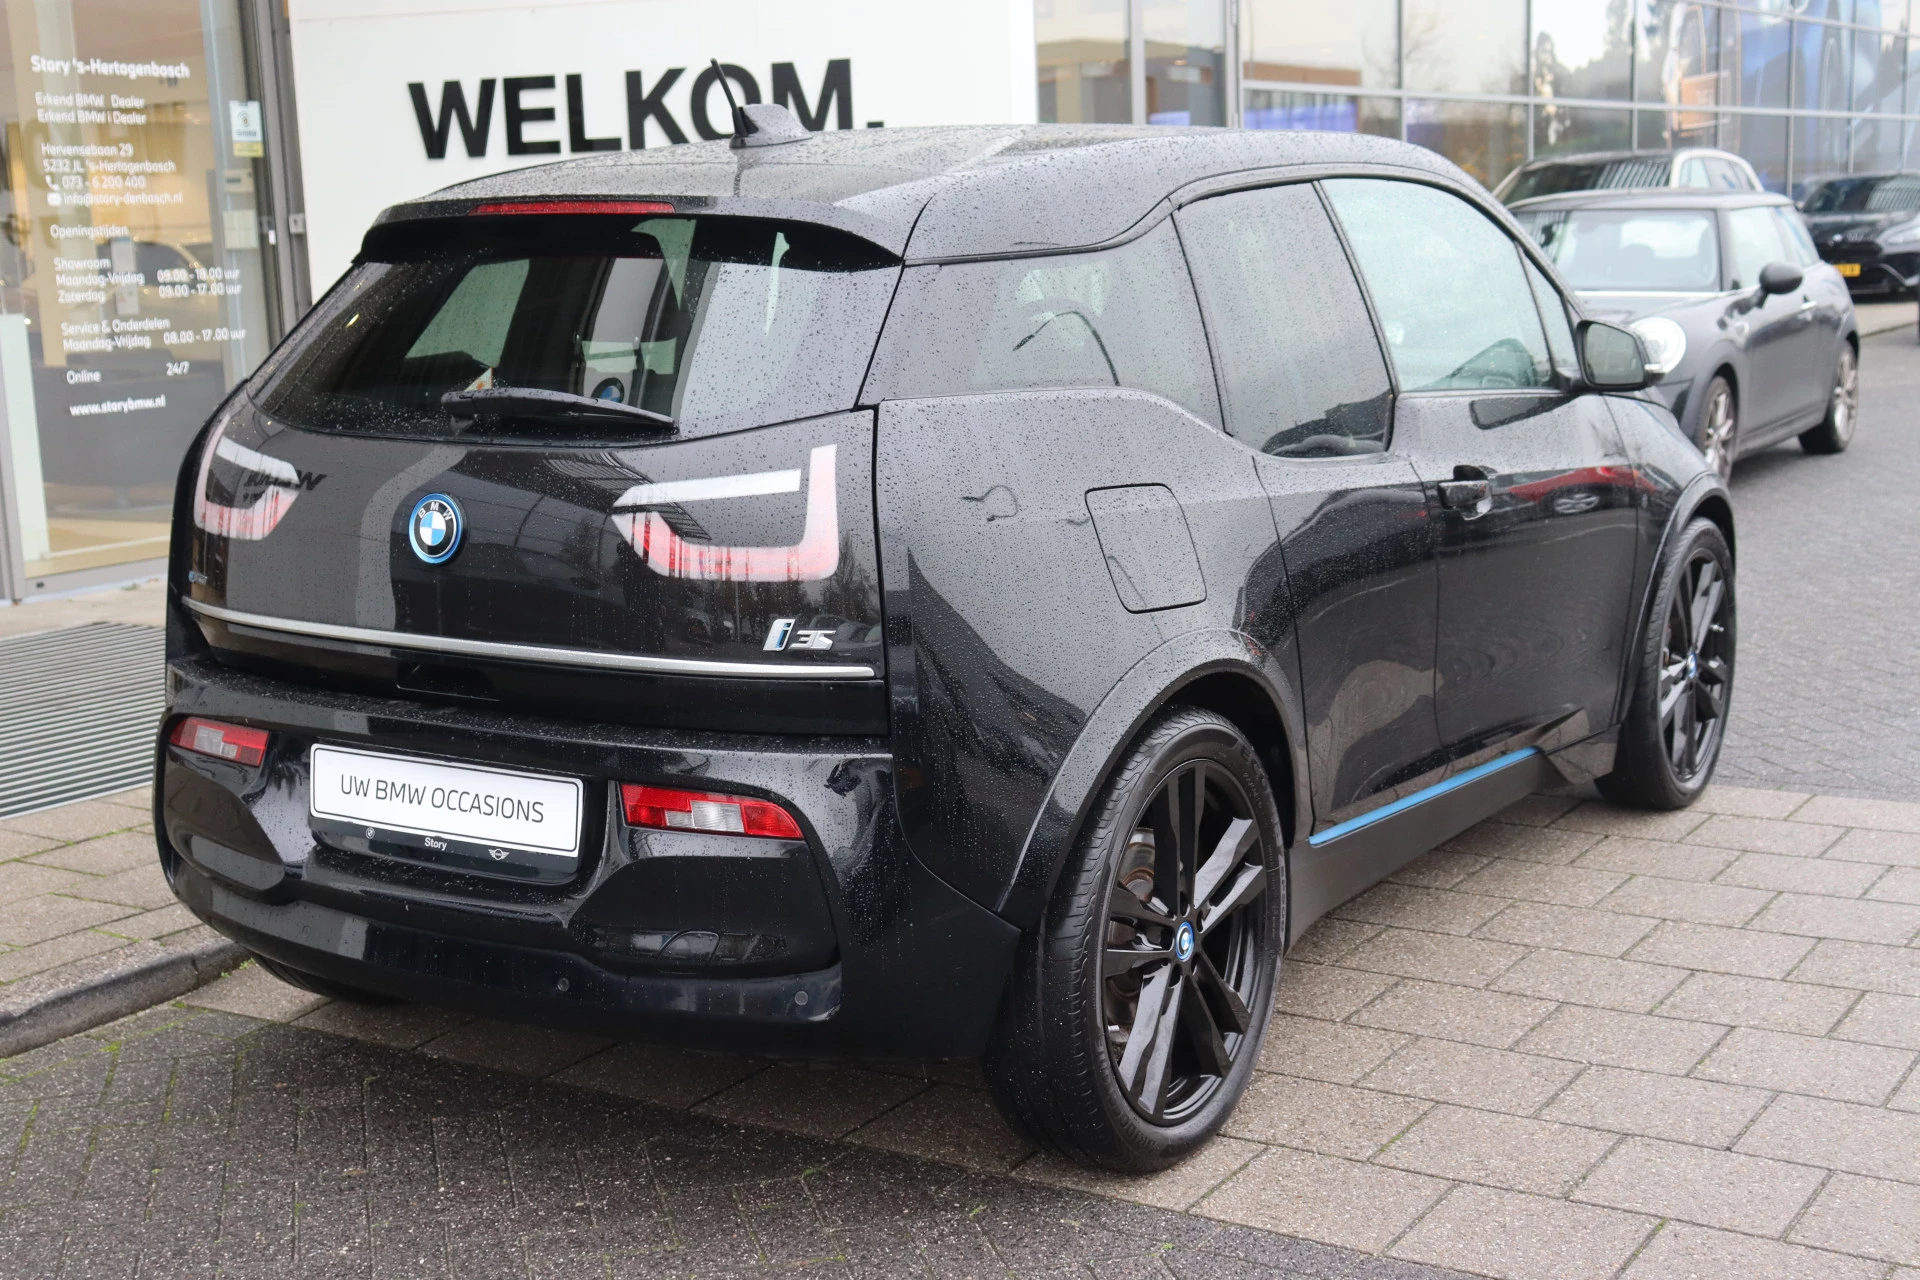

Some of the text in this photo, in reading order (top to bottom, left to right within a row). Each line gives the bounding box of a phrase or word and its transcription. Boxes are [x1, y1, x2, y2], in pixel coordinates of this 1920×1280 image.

[30, 54, 190, 79] Story 's-Hertogenbosch
[35, 91, 146, 109] Erkend BMW Dealer
[407, 58, 885, 160] WELKOM.
[37, 108, 75, 123] Erkend
[77, 110, 106, 124] BMW
[113, 111, 147, 125] Dealer
[43, 159, 70, 173] 5232
[86, 159, 176, 175] 's-Hertogenbosch
[61, 175, 83, 189] 073
[92, 175, 101, 189] 6
[102, 175, 123, 189] 200
[124, 175, 145, 189] 400
[50, 224, 129, 240] Openingstijden
[53, 257, 111, 271] Showroom
[55, 272, 146, 287] Maandag-Vrijdag
[224, 269, 240, 279] uur
[58, 289, 106, 305] Zaterdag
[226, 283, 242, 295] uur
[61, 318, 171, 336] Service & Onderdelen
[63, 335, 152, 352] Maandag-Vrijdag
[163, 330, 194, 345] 08.00
[231, 329, 246, 339] uur
[67, 361, 190, 385] Online 24/7
[70, 394, 167, 416] www.storybmw.nl
[418, 502, 453, 521] BMW
[341, 773, 545, 823] UW BMW OCCASIONS
[424, 836, 448, 851] Story
